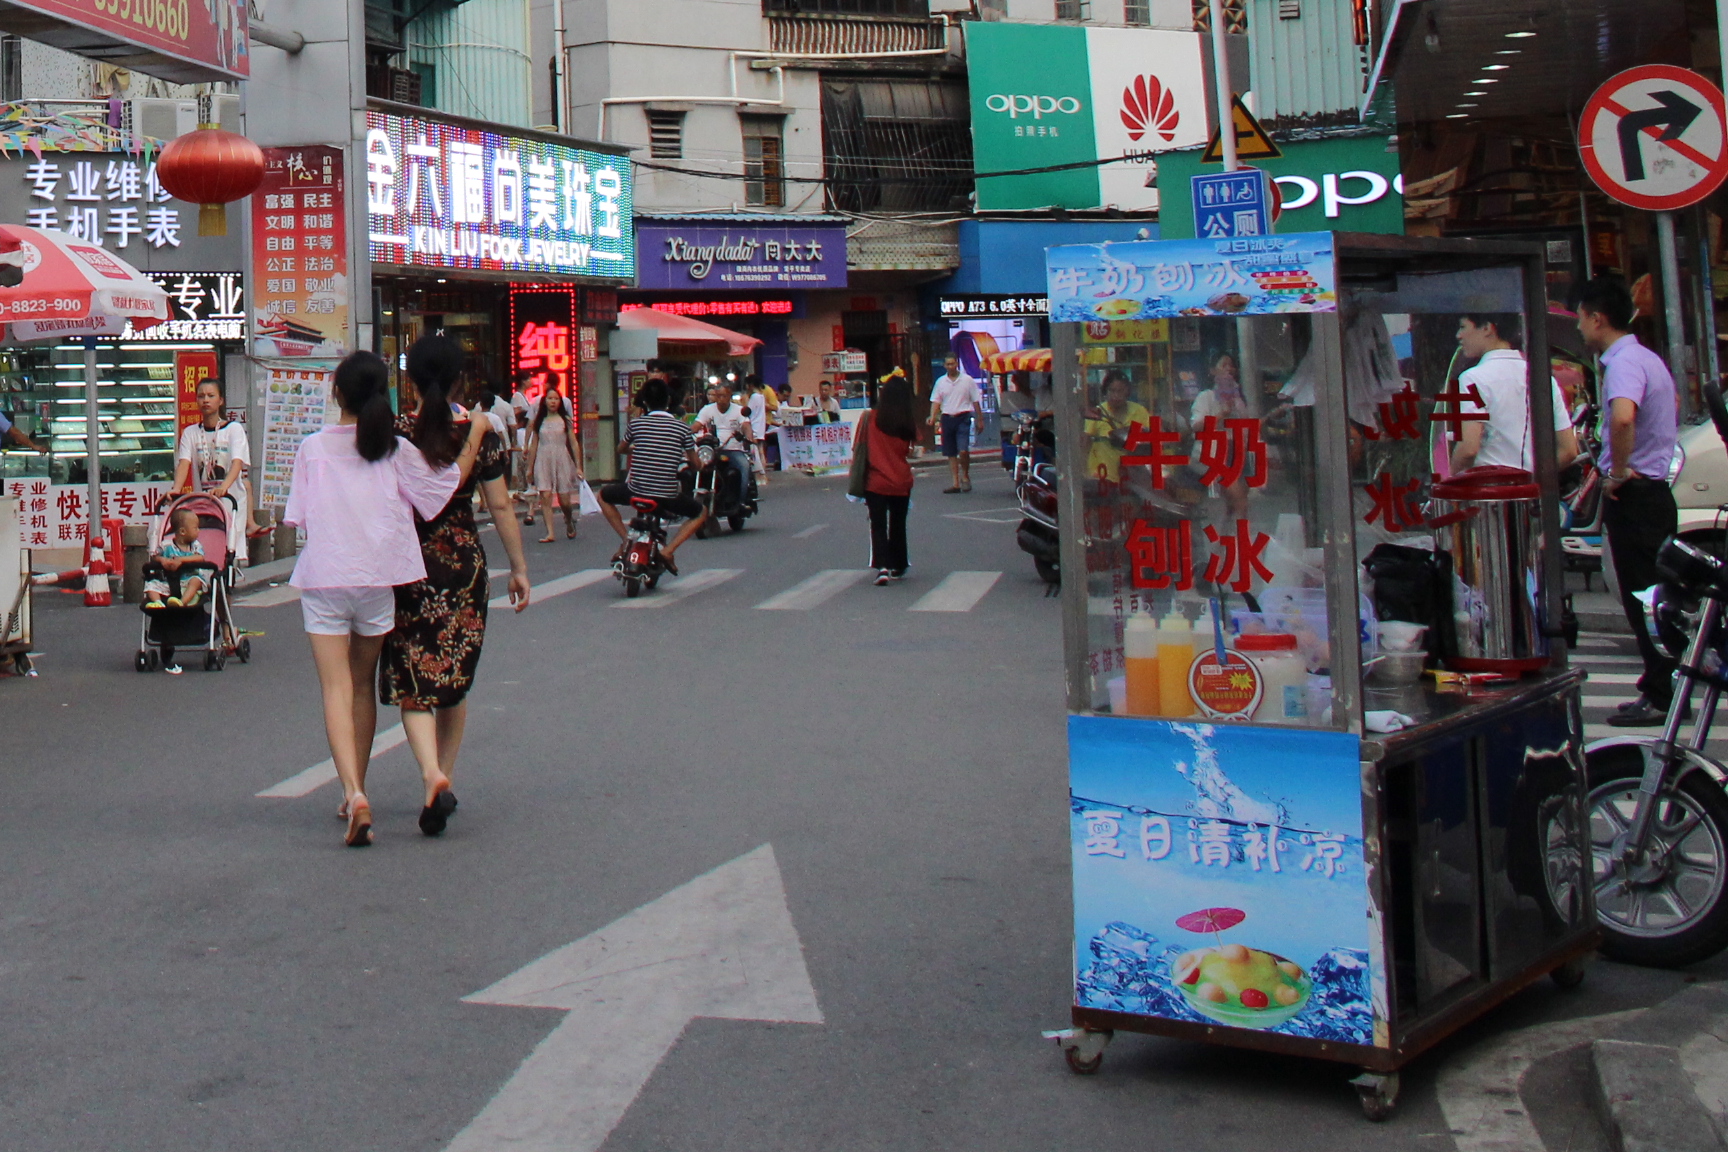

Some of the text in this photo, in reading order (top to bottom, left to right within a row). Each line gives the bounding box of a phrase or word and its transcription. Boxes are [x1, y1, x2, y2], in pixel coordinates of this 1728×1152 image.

[287, 153, 318, 186] 核心
[367, 128, 621, 238] 金六福尚美珠宝
[265, 193, 333, 209] 富强 民主
[265, 214, 333, 230] 文明 和谐
[266, 235, 333, 251] 自由 平等
[412, 225, 591, 266] KIN LIU FOOK JEWELRY
[266, 257, 334, 272] 公正 法治
[266, 278, 335, 293] 爱国 敬业
[1056, 260, 1248, 298] 牛奶刨冰
[267, 299, 335, 314] 诚信 友善
[1120, 415, 1268, 490] 牛奶
[9, 483, 47, 496] 专业
[1125, 519, 1274, 592] 刨冰
